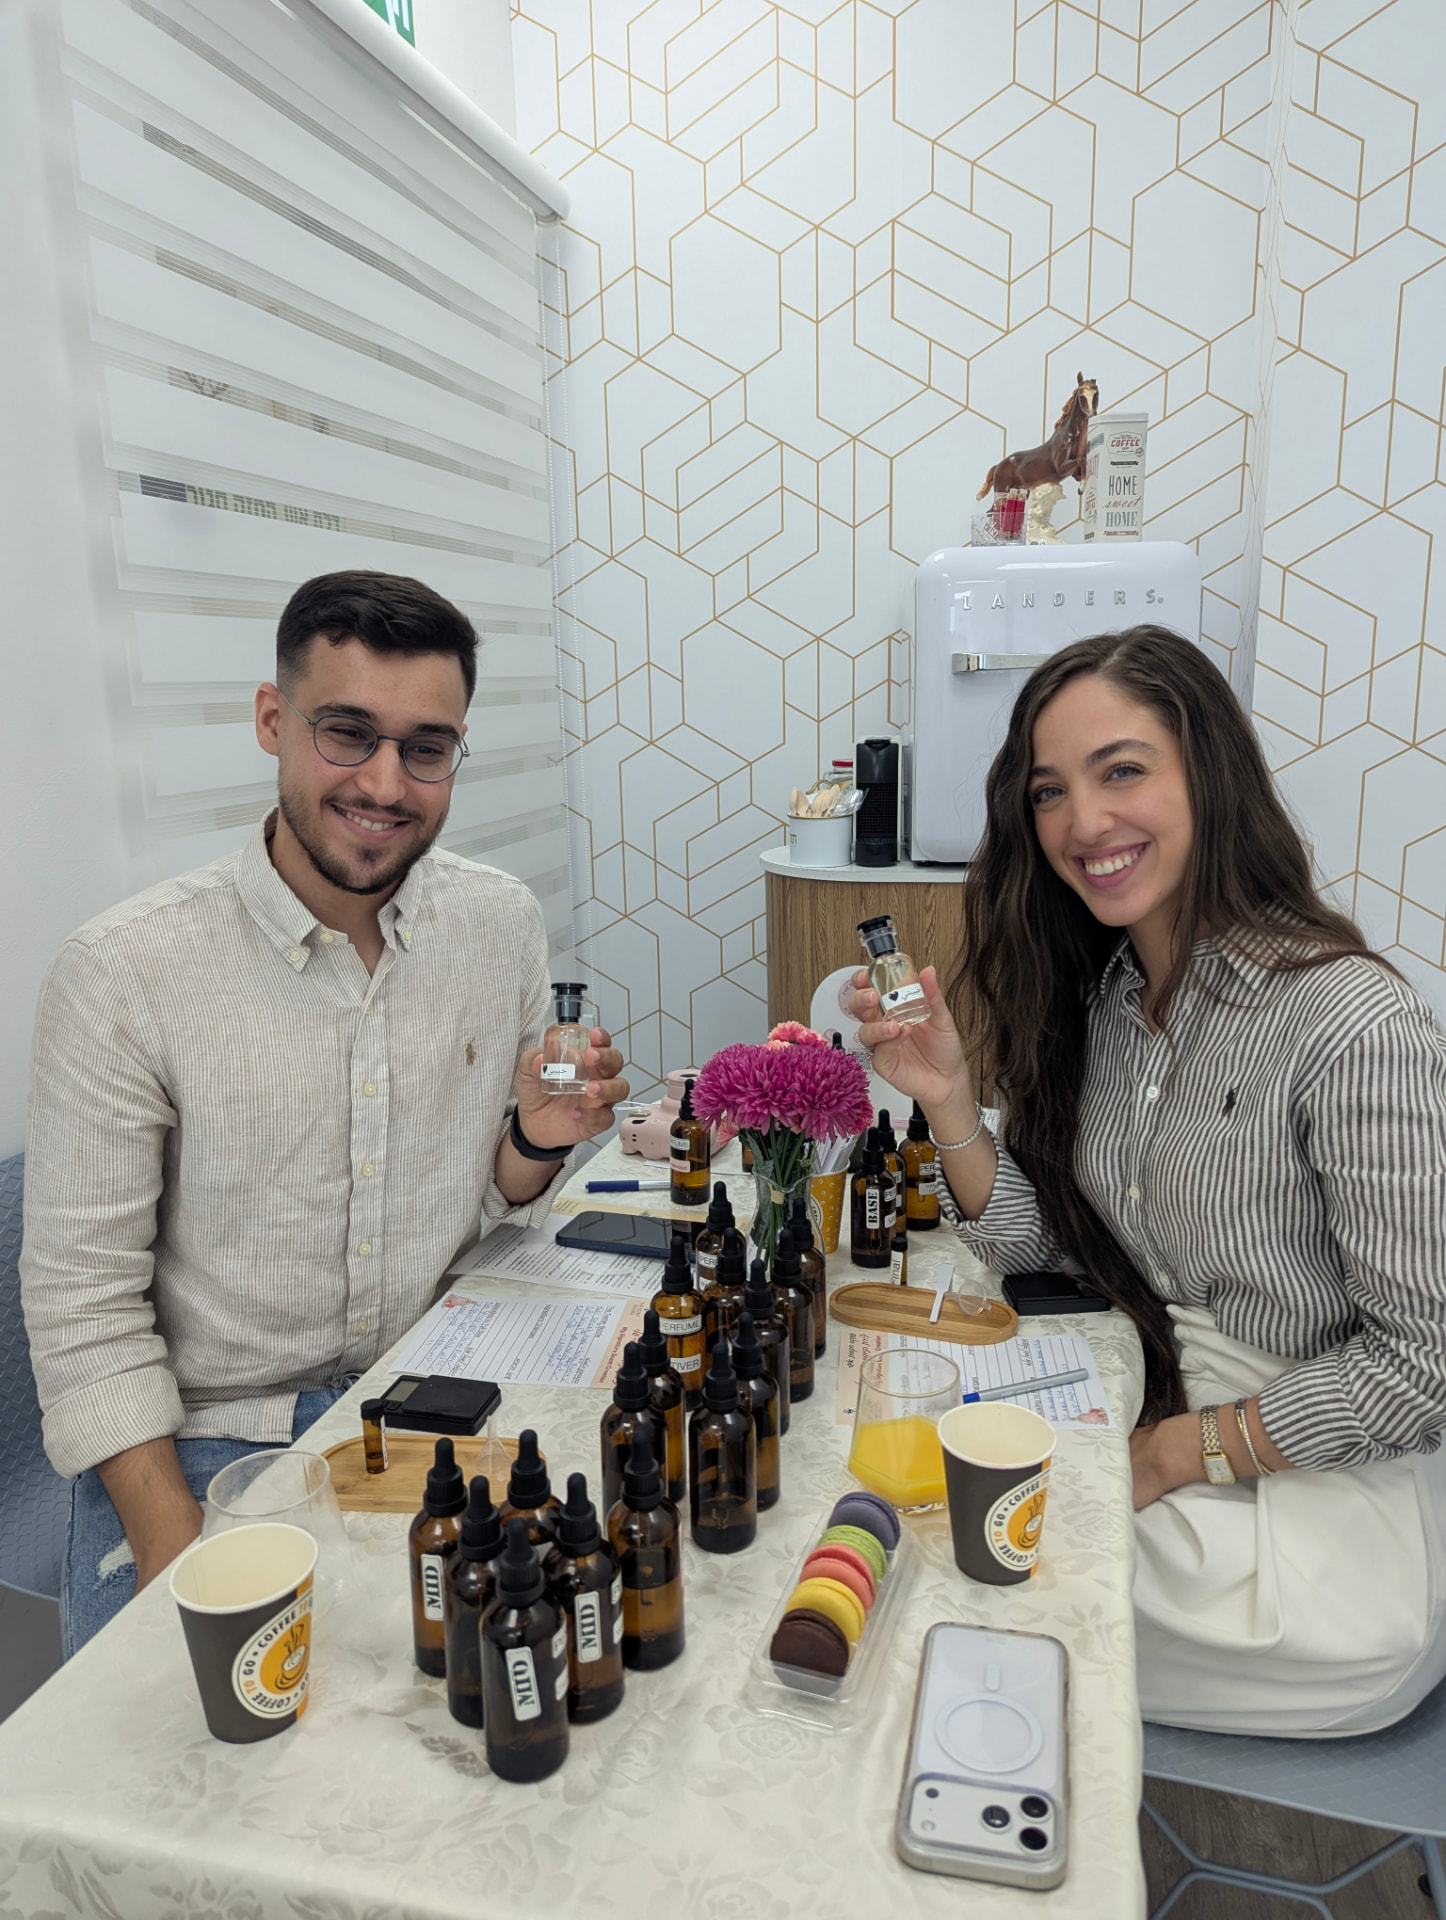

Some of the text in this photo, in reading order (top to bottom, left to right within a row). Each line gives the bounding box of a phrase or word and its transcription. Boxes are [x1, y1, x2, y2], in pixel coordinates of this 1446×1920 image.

[1111, 439, 1140, 447] COFFEE
[1108, 475, 1137, 496] HOME
[1103, 496, 1142, 509] sweet
[1105, 511, 1138, 527] HOME
[867, 1192, 879, 1224] BASE
[662, 1320, 700, 1331] ERFUME
[671, 1359, 699, 1370] TIVER
[1008, 1481, 1040, 1506] COFFEE
[994, 1513, 1029, 1563] COFFEE TO GO
[424, 1565, 442, 1610] MID
[257, 1599, 308, 1648] COFFEE TO
[580, 1603, 598, 1650] MID
[243, 1660, 291, 1709] COFFEE TO GO
[512, 1660, 536, 1707] MID
